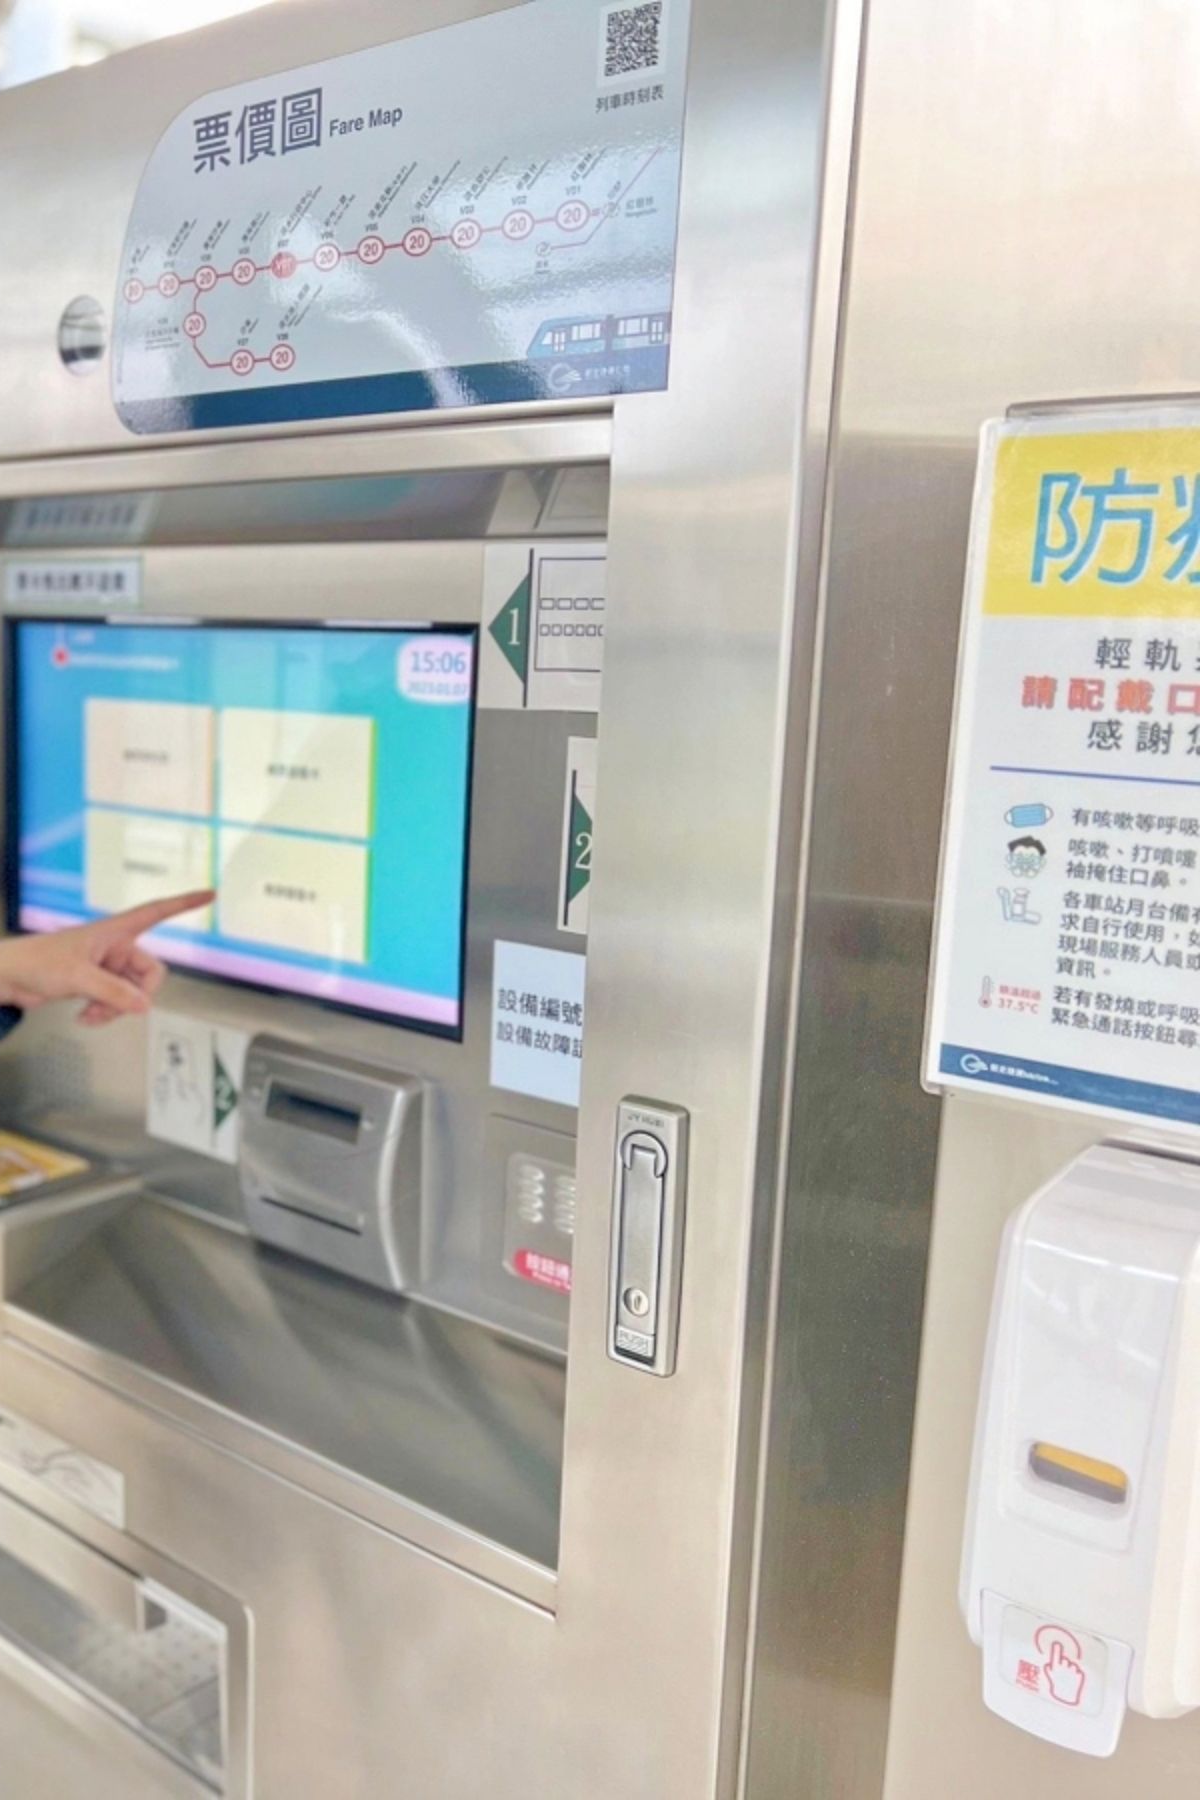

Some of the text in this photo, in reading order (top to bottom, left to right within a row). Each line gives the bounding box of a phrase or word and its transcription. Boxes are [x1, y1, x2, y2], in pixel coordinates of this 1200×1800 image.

[193, 87, 403, 174] 票價圖 Fare Map
[507, 609, 522, 645] 1
[411, 650, 467, 675] 15:06
[1095, 637, 1200, 671] 輕軌
[1072, 808, 1200, 837] 有咳嗽等呼吸
[575, 832, 592, 869] 2
[497, 988, 583, 1027] 設備編號
